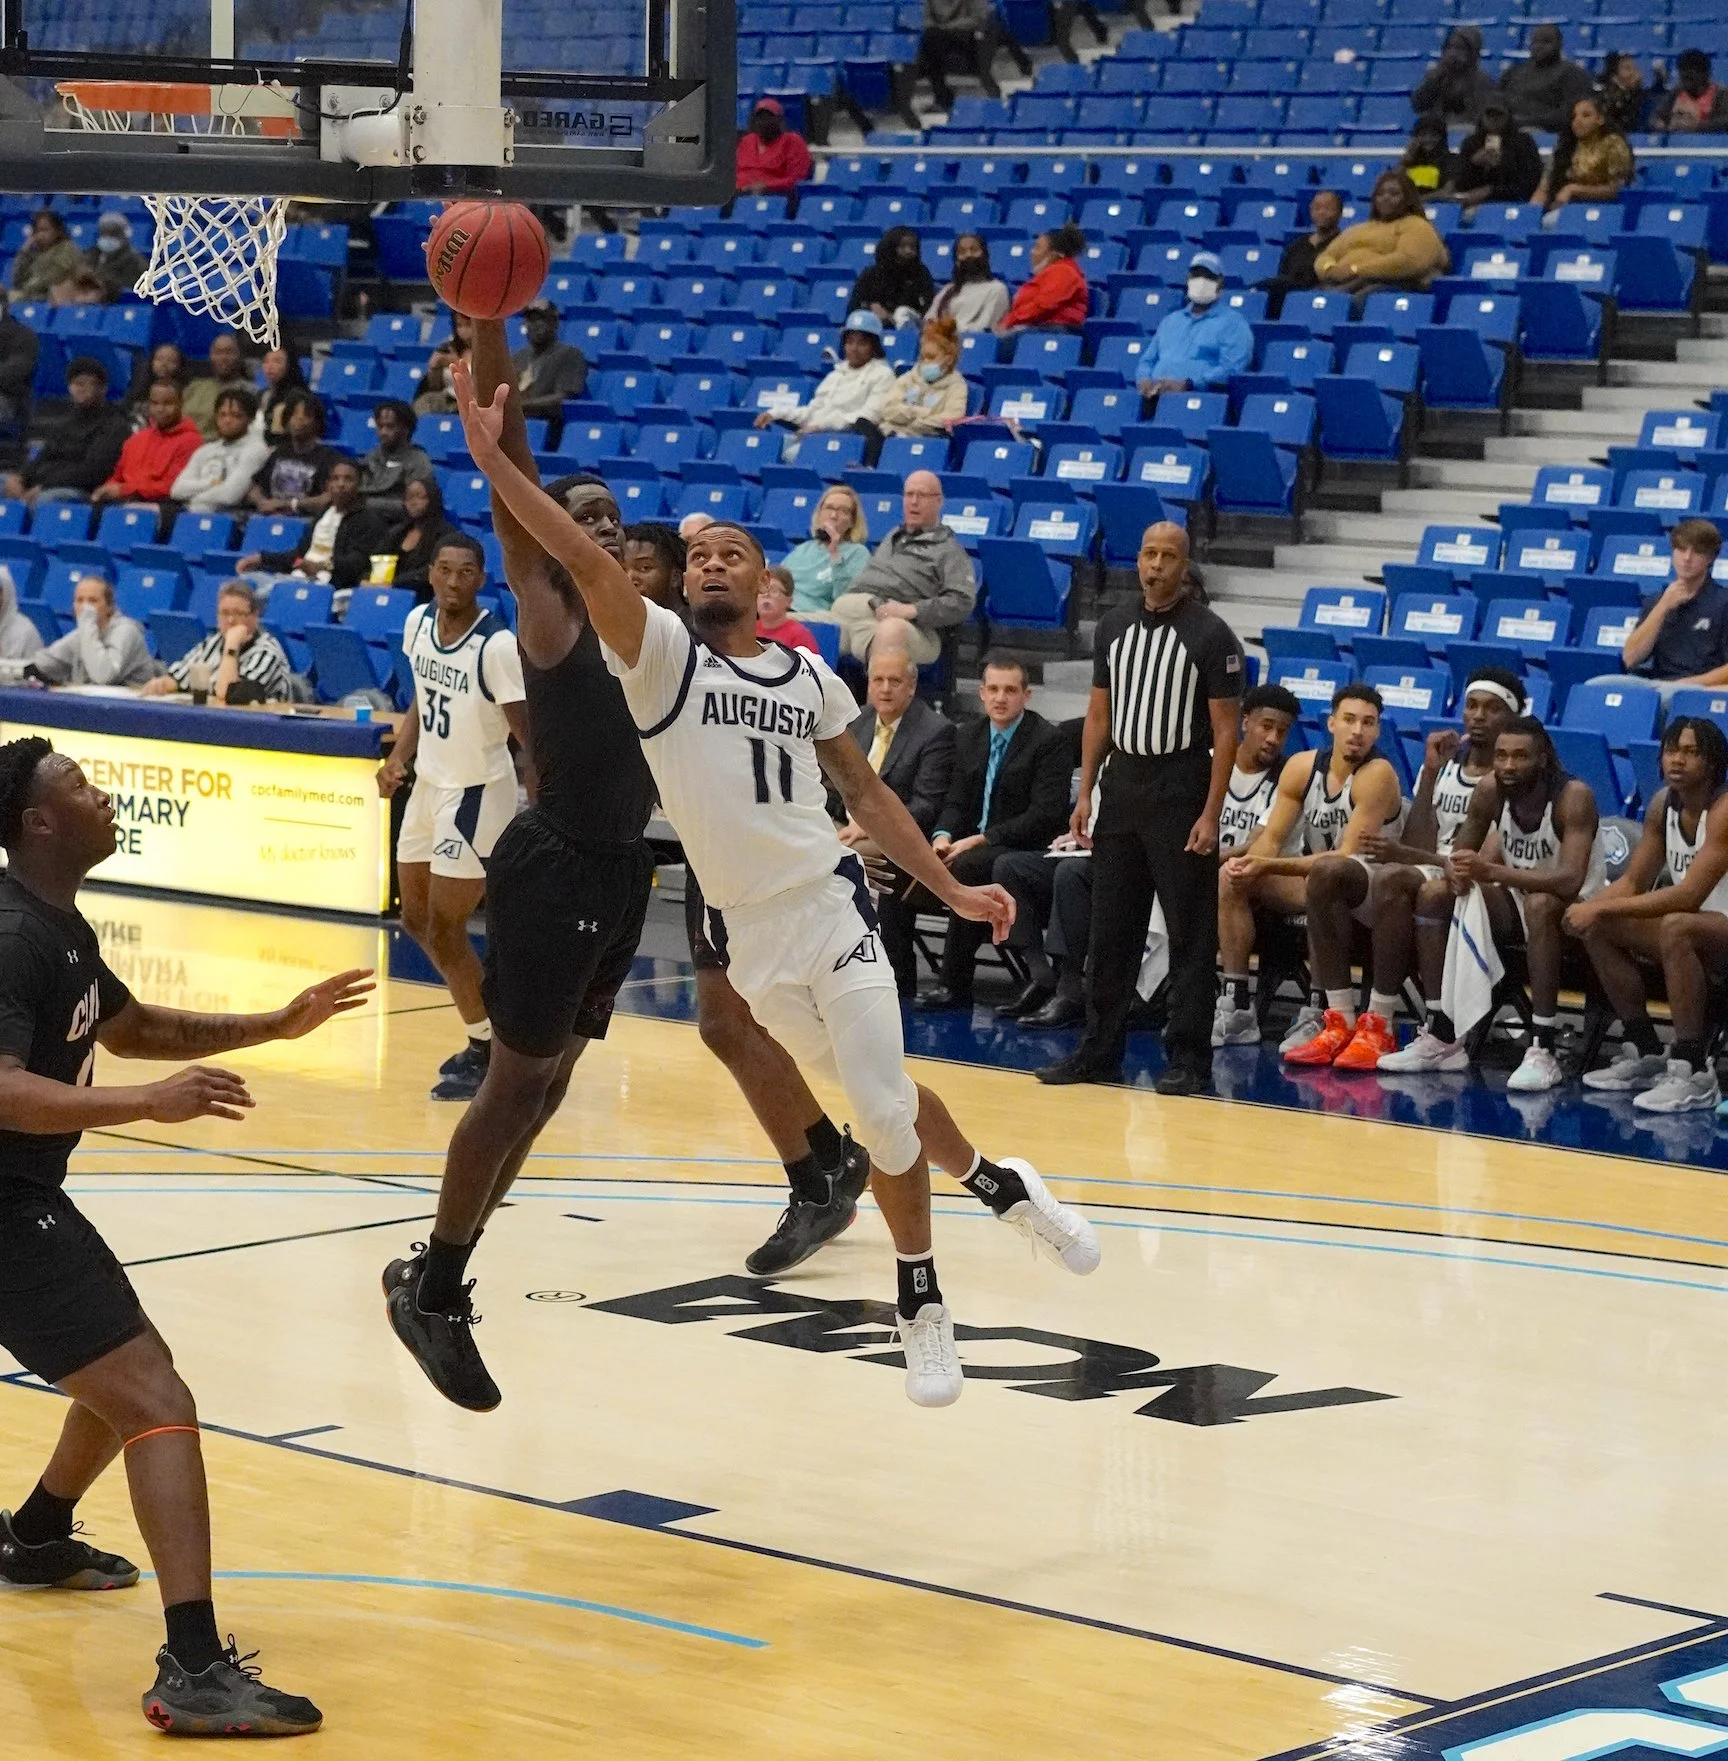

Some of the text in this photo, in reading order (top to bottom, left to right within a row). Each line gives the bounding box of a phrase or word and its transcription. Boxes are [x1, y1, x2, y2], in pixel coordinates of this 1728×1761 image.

[413, 655, 468, 694] AUGUSTA
[422, 686, 454, 740] 35
[702, 691, 817, 740] AUGUSTA
[182, 769, 233, 800] FOR
[745, 735, 794, 805] 11
[251, 784, 365, 807] cpcfamilymed.com
[320, 844, 357, 860] knows
